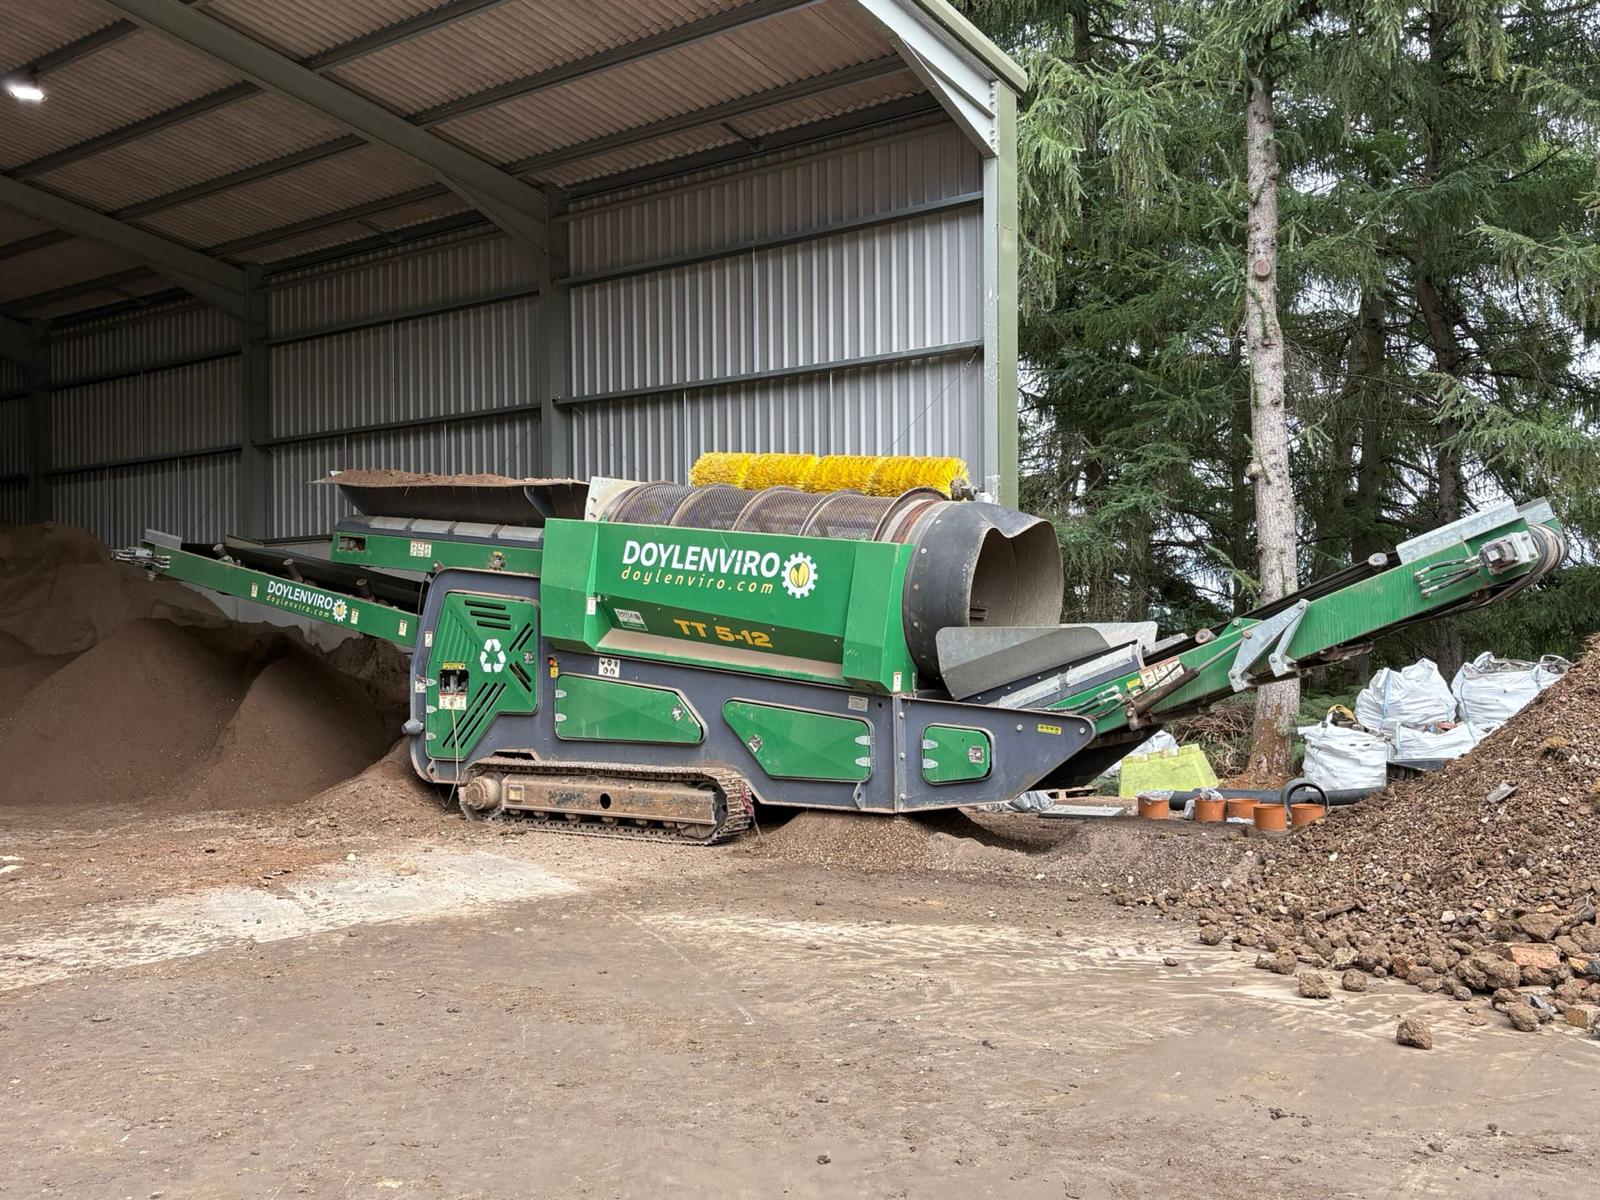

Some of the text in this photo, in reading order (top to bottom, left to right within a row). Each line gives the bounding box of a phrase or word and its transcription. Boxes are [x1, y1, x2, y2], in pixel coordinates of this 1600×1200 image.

[622, 540, 781, 578] DOYLENVIRO
[267, 580, 333, 610] DOYLENVIRO
[621, 566, 774, 595] doylenviro.com
[266, 594, 330, 618] doylenviro.com
[673, 619, 774, 648] TT 5-12
